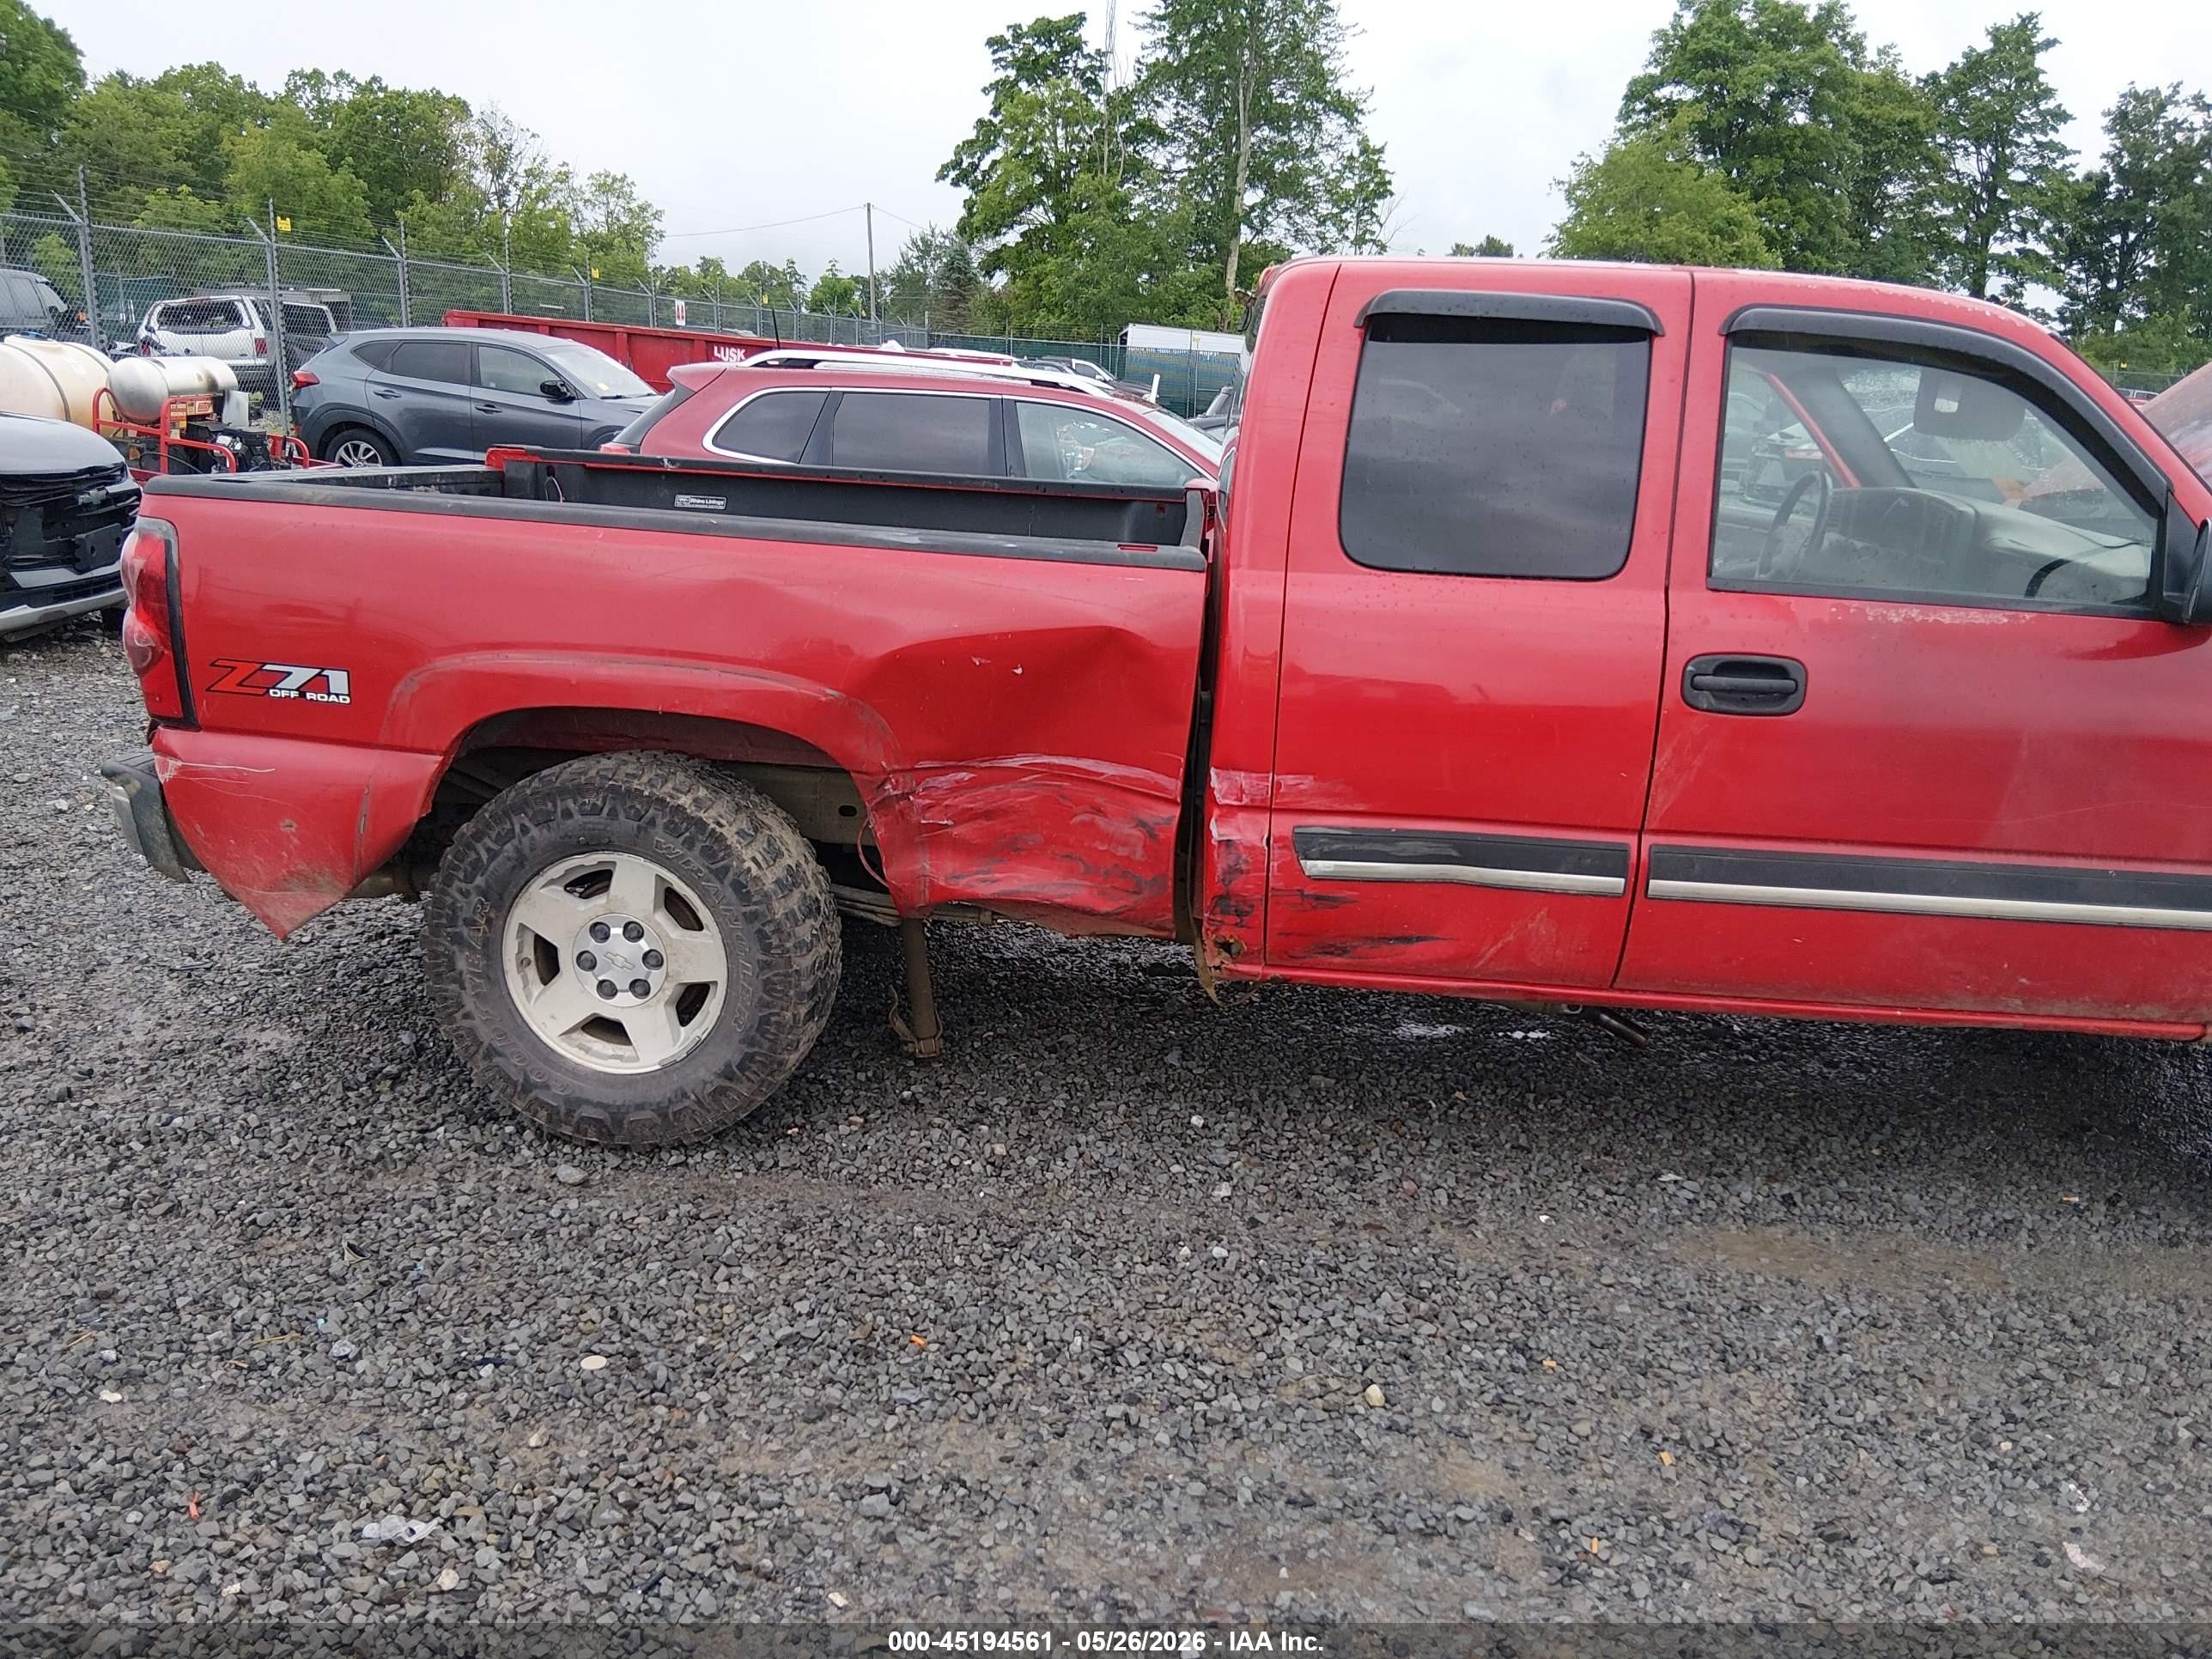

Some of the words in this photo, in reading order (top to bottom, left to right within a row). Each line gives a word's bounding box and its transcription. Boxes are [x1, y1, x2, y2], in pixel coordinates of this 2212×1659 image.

[714, 345, 746, 362] LUSK
[205, 657, 350, 697] Z71
[269, 689, 300, 699] OFF
[306, 691, 350, 705] ROAD
[653, 837, 754, 1033] WRANGLER
[465, 896, 574, 1097] GOODYEAR
